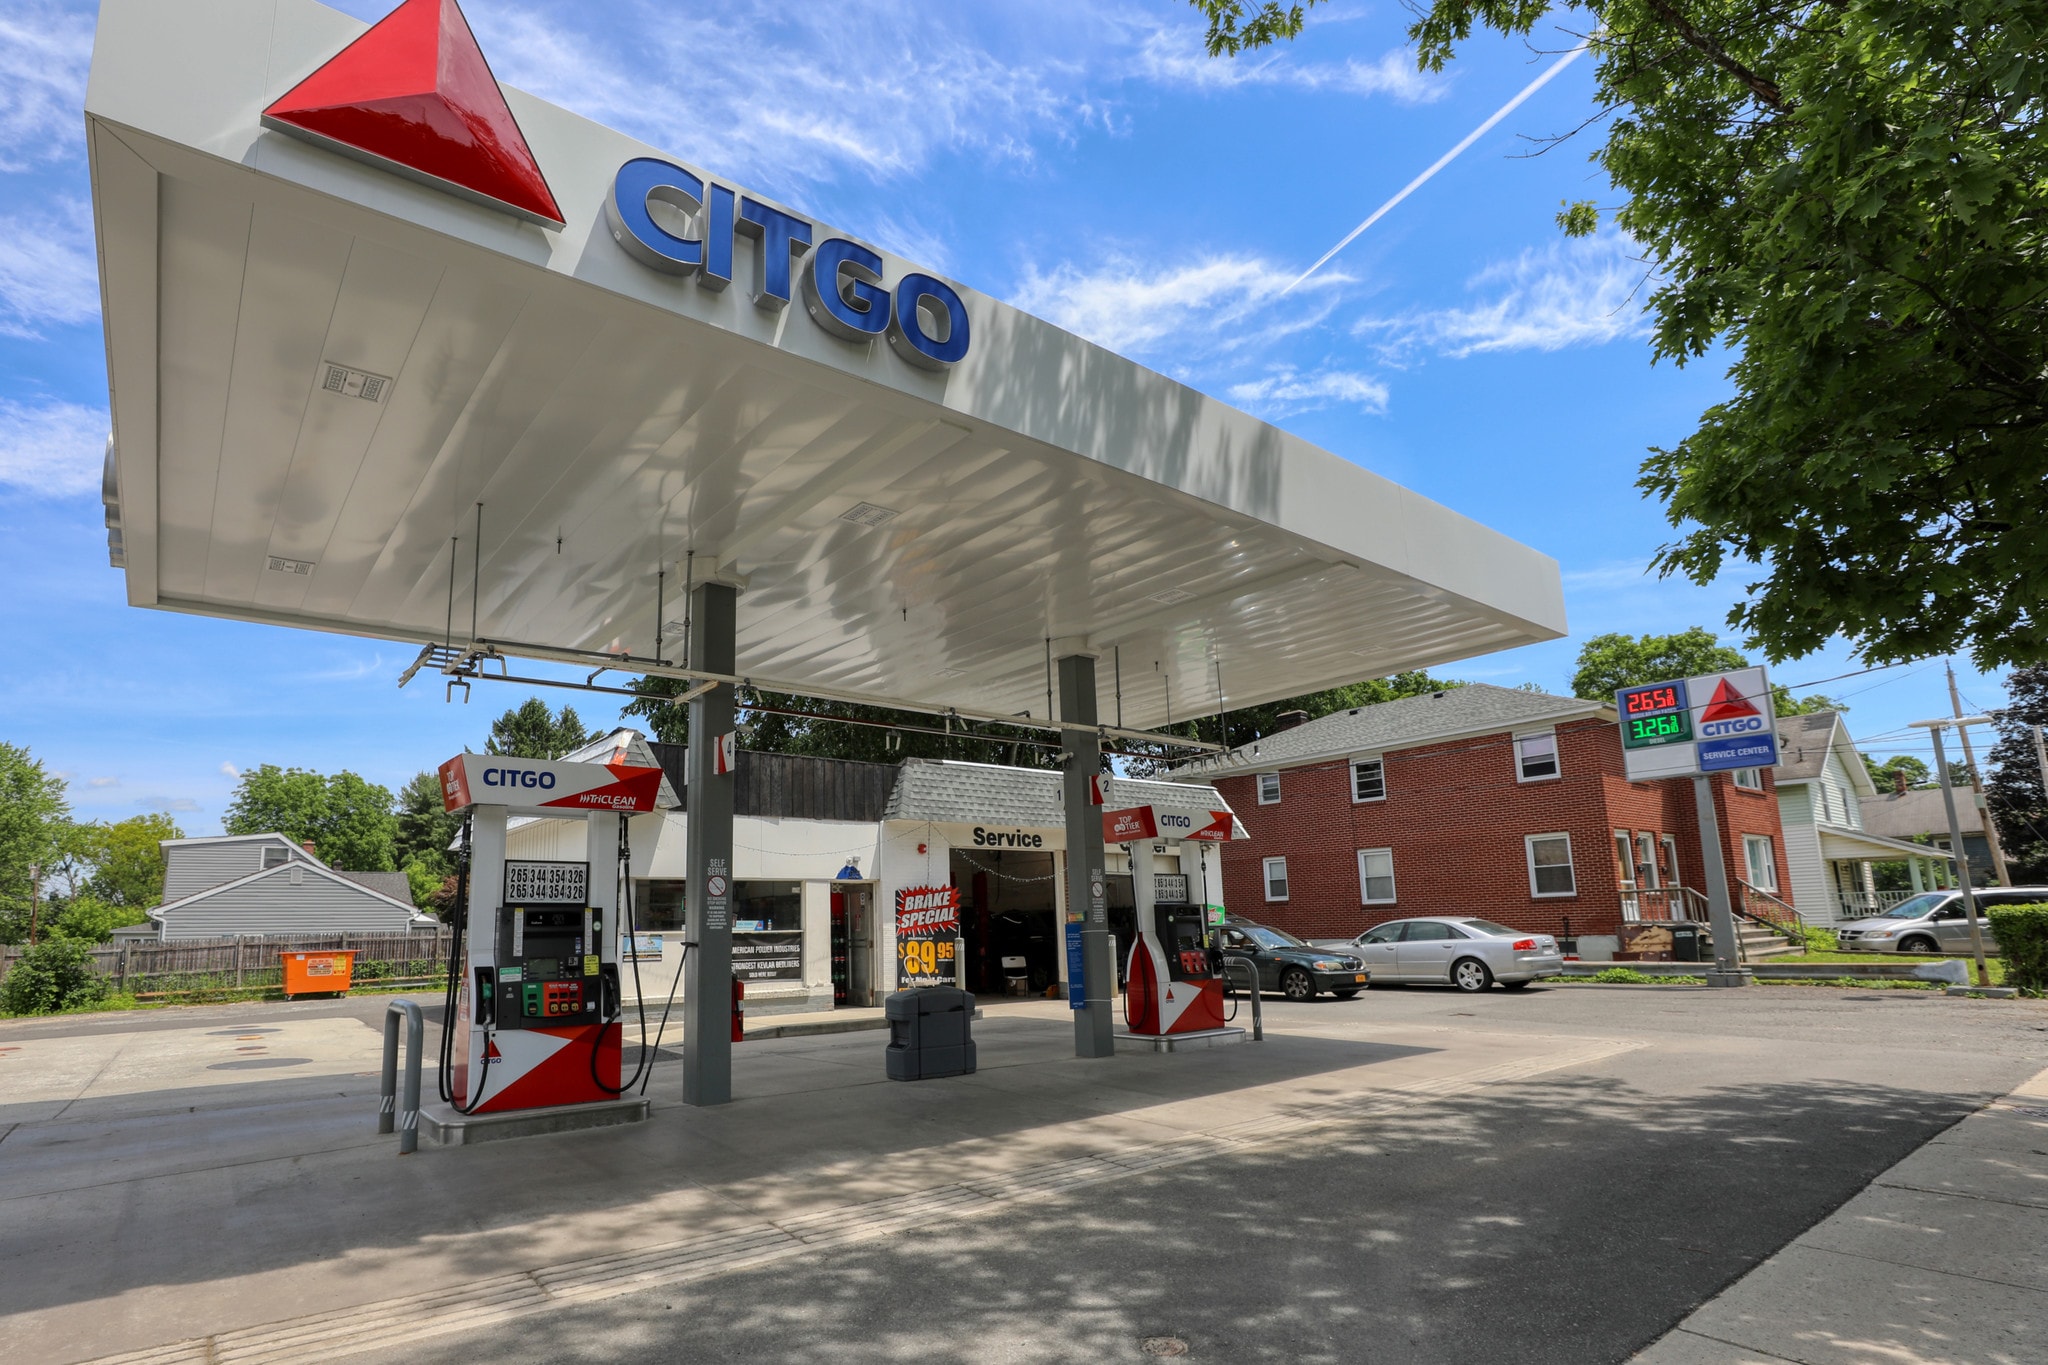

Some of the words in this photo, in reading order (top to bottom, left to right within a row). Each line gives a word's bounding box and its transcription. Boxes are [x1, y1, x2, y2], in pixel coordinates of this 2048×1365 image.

[607, 156, 971, 369] CITGO
[1702, 717, 1762, 736] CITGO
[1703, 749, 1737, 760] SERVICE
[1737, 745, 1769, 756] CENTER
[483, 768, 556, 790] CITGO
[1103, 780, 1110, 793] 2
[590, 794, 637, 806] TriCLEAN
[1057, 789, 1061, 801] 1
[1118, 815, 1133, 825] TOP
[1125, 821, 1141, 831] TIER
[1160, 814, 1191, 828] CITGO
[973, 826, 1042, 848] Service
[709, 858, 726, 868] SELF
[510, 868, 528, 883] 265
[530, 868, 547, 883] 344
[549, 869, 566, 884] 354
[567, 869, 584, 884] 326
[707, 867, 728, 876] SERVE
[509, 883, 527, 899] 265
[529, 884, 546, 899] 344
[548, 884, 565, 900] 354
[566, 885, 583, 900] 326
[904, 890, 952, 912] BRAKE
[901, 907, 955, 929] SPECIAL
[731, 945, 755, 955] MERICAN
[755, 945, 773, 954] POWER
[773, 944, 801, 953] INDUSTRIES
[756, 960, 776, 970] KEVLAR
[480, 1057, 502, 1065] CTGO
